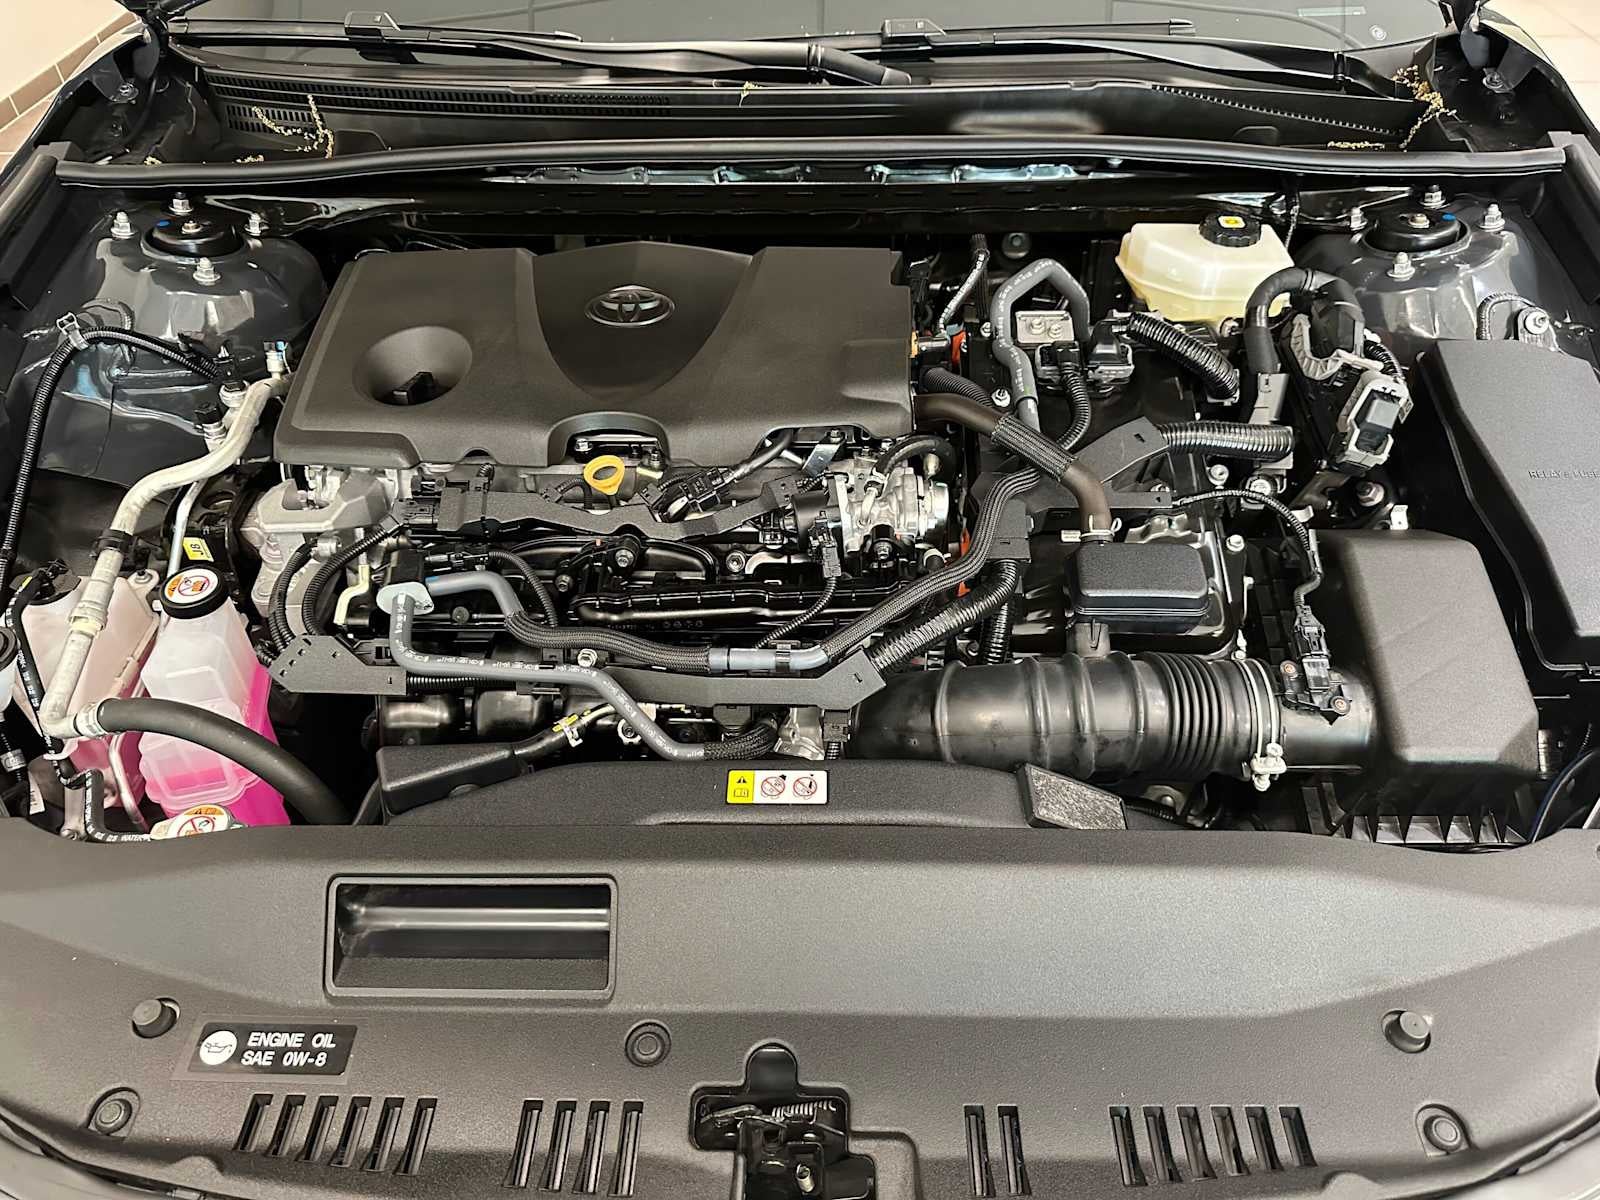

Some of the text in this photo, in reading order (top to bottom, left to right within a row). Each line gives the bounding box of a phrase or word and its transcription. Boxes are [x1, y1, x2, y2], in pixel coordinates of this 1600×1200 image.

[247, 1031, 336, 1048] ENGINE OIL
[241, 1050, 327, 1067] SAE 0W-8
